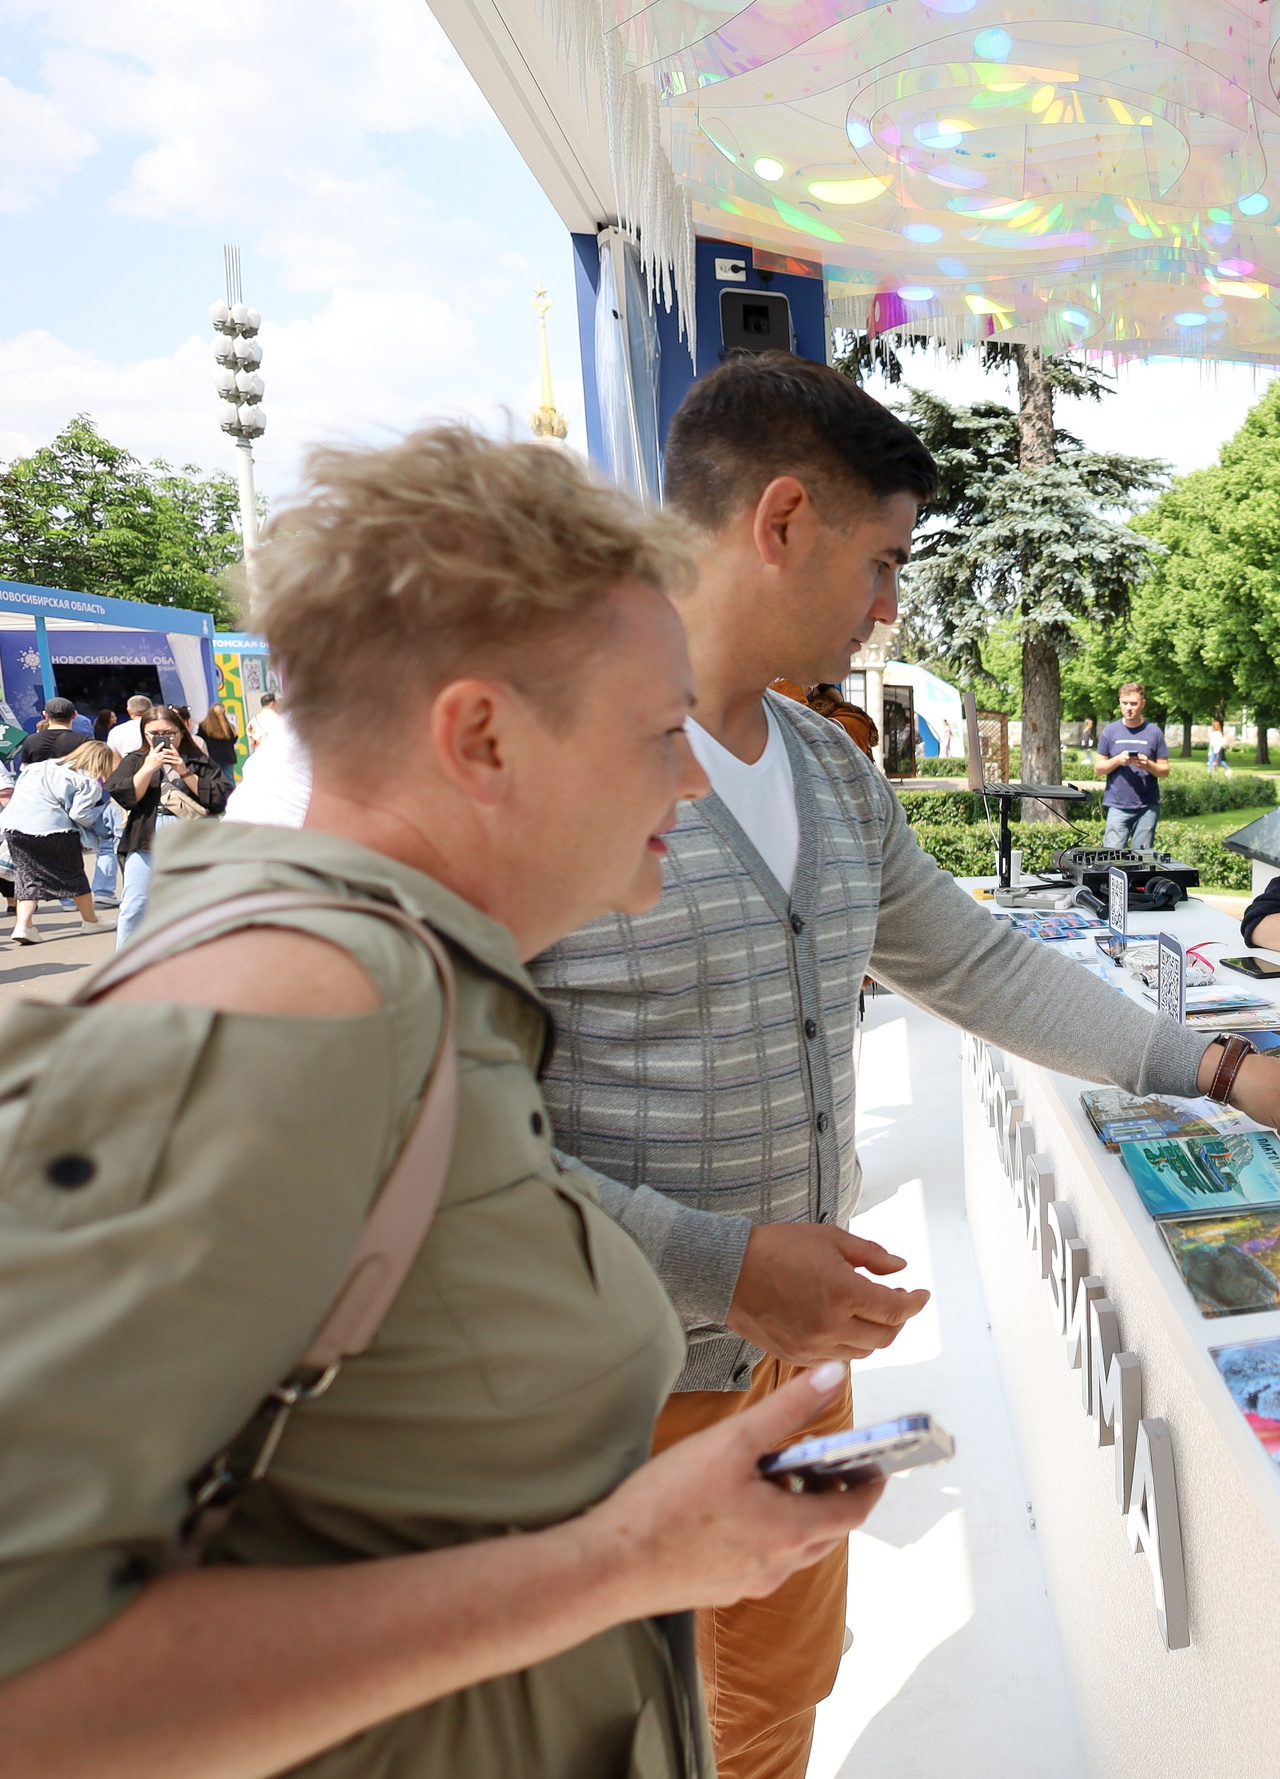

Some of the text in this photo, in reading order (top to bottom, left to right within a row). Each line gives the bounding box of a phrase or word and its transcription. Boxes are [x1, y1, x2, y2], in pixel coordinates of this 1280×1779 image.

[70, 601, 106, 615] ОБЛАСТЬ
[212, 640, 258, 648] ТОМСКАЯ
[51, 655, 147, 665] НОВОСИБИРСКАЯ
[1257, 1138, 1279, 1160] ПЛАТО
